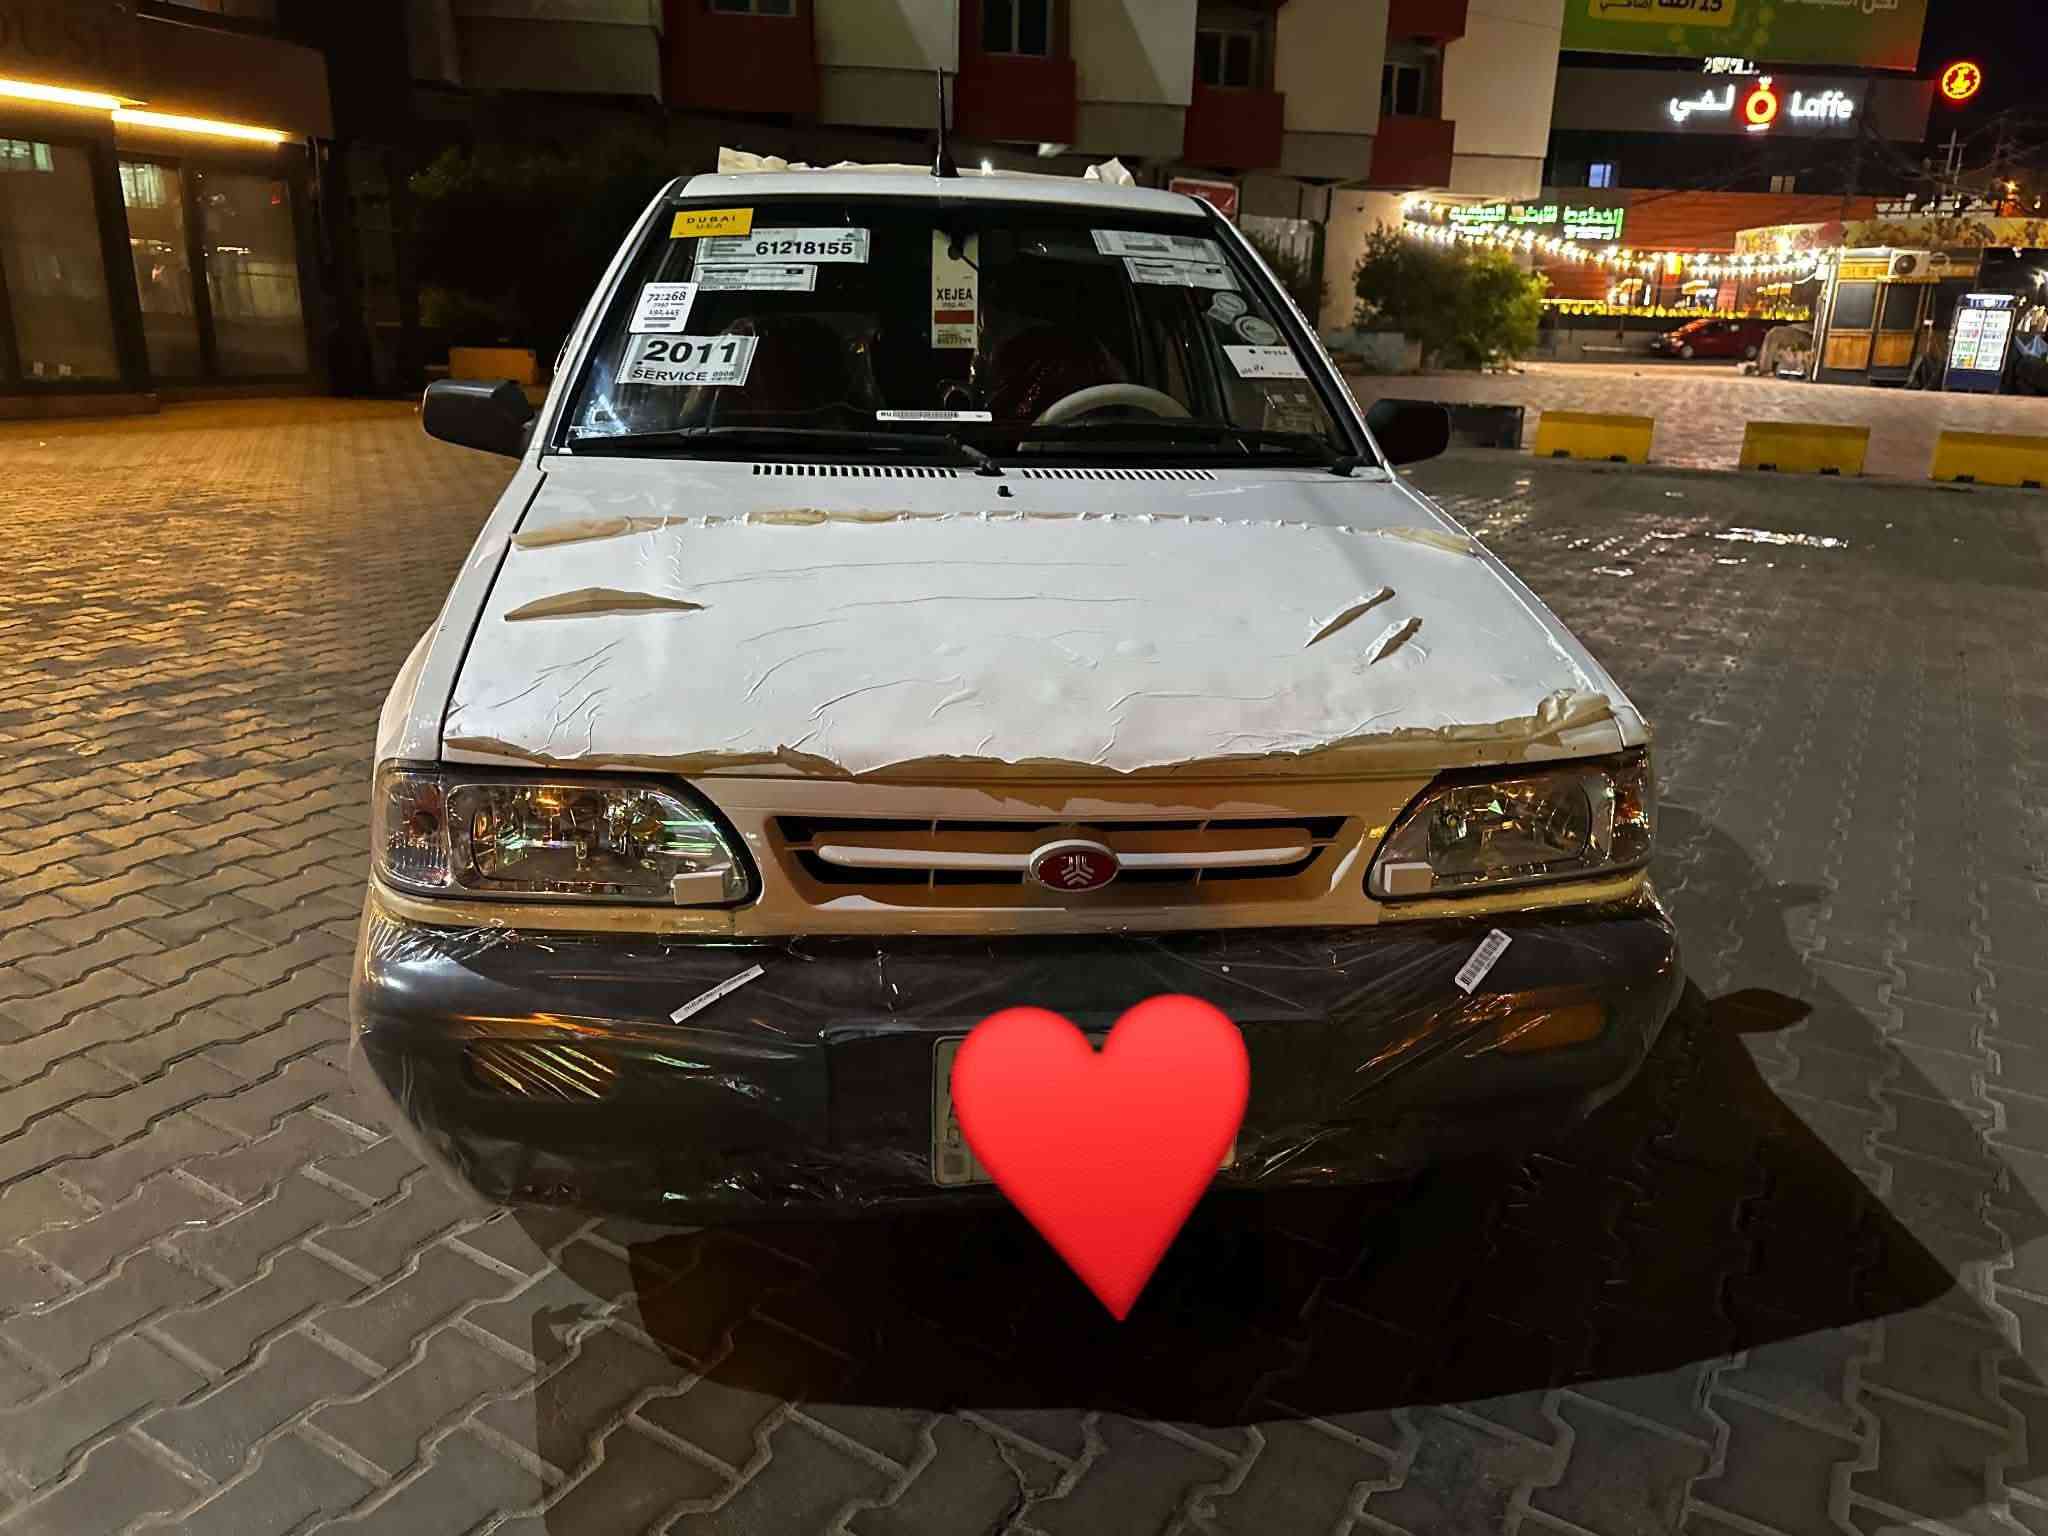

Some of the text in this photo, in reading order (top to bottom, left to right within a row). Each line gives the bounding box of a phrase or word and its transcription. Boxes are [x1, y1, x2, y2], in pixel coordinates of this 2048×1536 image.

[1790, 90, 1854, 119] Laffe
[755, 240, 853, 256] 61218155
[642, 340, 737, 364] 2011
[631, 369, 709, 382] SERVICE
